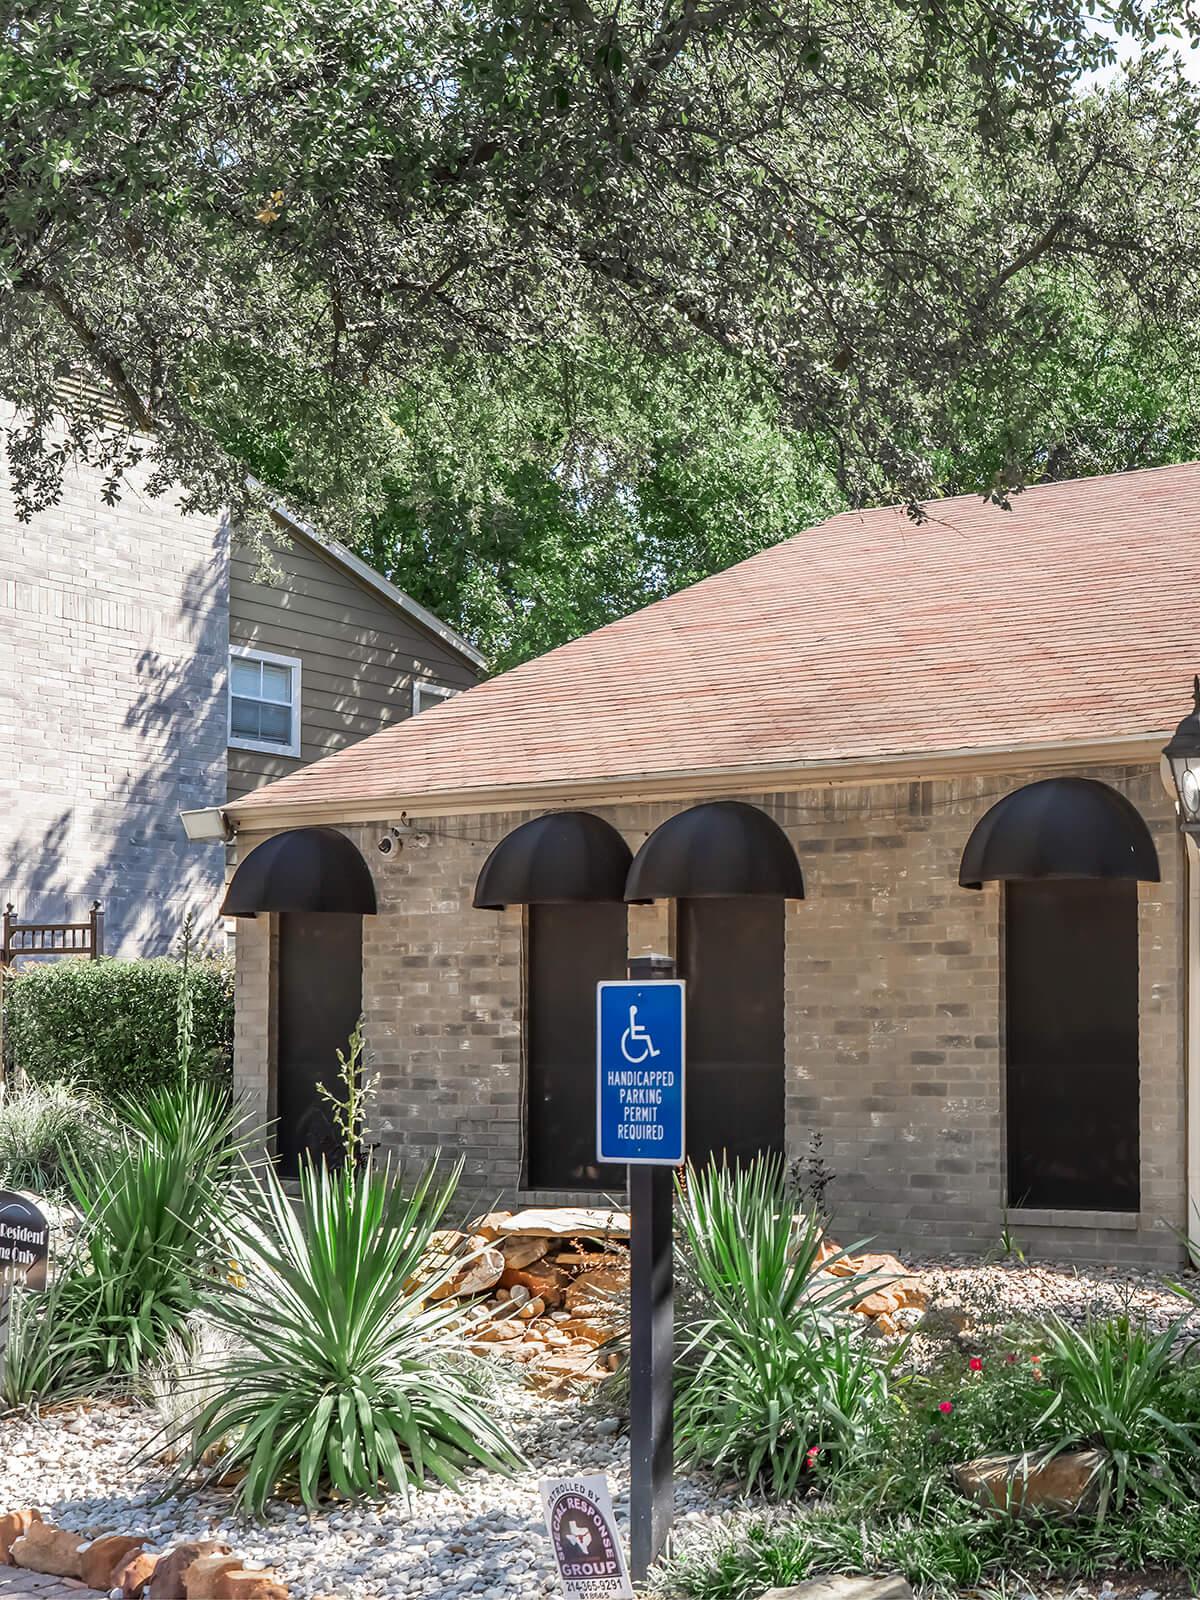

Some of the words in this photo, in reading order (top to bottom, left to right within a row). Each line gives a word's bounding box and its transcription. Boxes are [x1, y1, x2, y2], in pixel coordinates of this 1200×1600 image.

[607, 1071, 674, 1087] HANDICAPPED
[619, 1089, 662, 1105] PARKING
[623, 1106, 658, 1122] PERMIT
[617, 1124, 664, 1140] REQUIRED
[548, 1483, 585, 1509] PATROLLED
[587, 1490, 600, 1503] BY
[553, 1503, 568, 1561] SPECIAL
[567, 1497, 615, 1559] RESPONSE
[562, 1561, 617, 1576] GROUP
[566, 1579, 623, 1592] 214-365-9291
